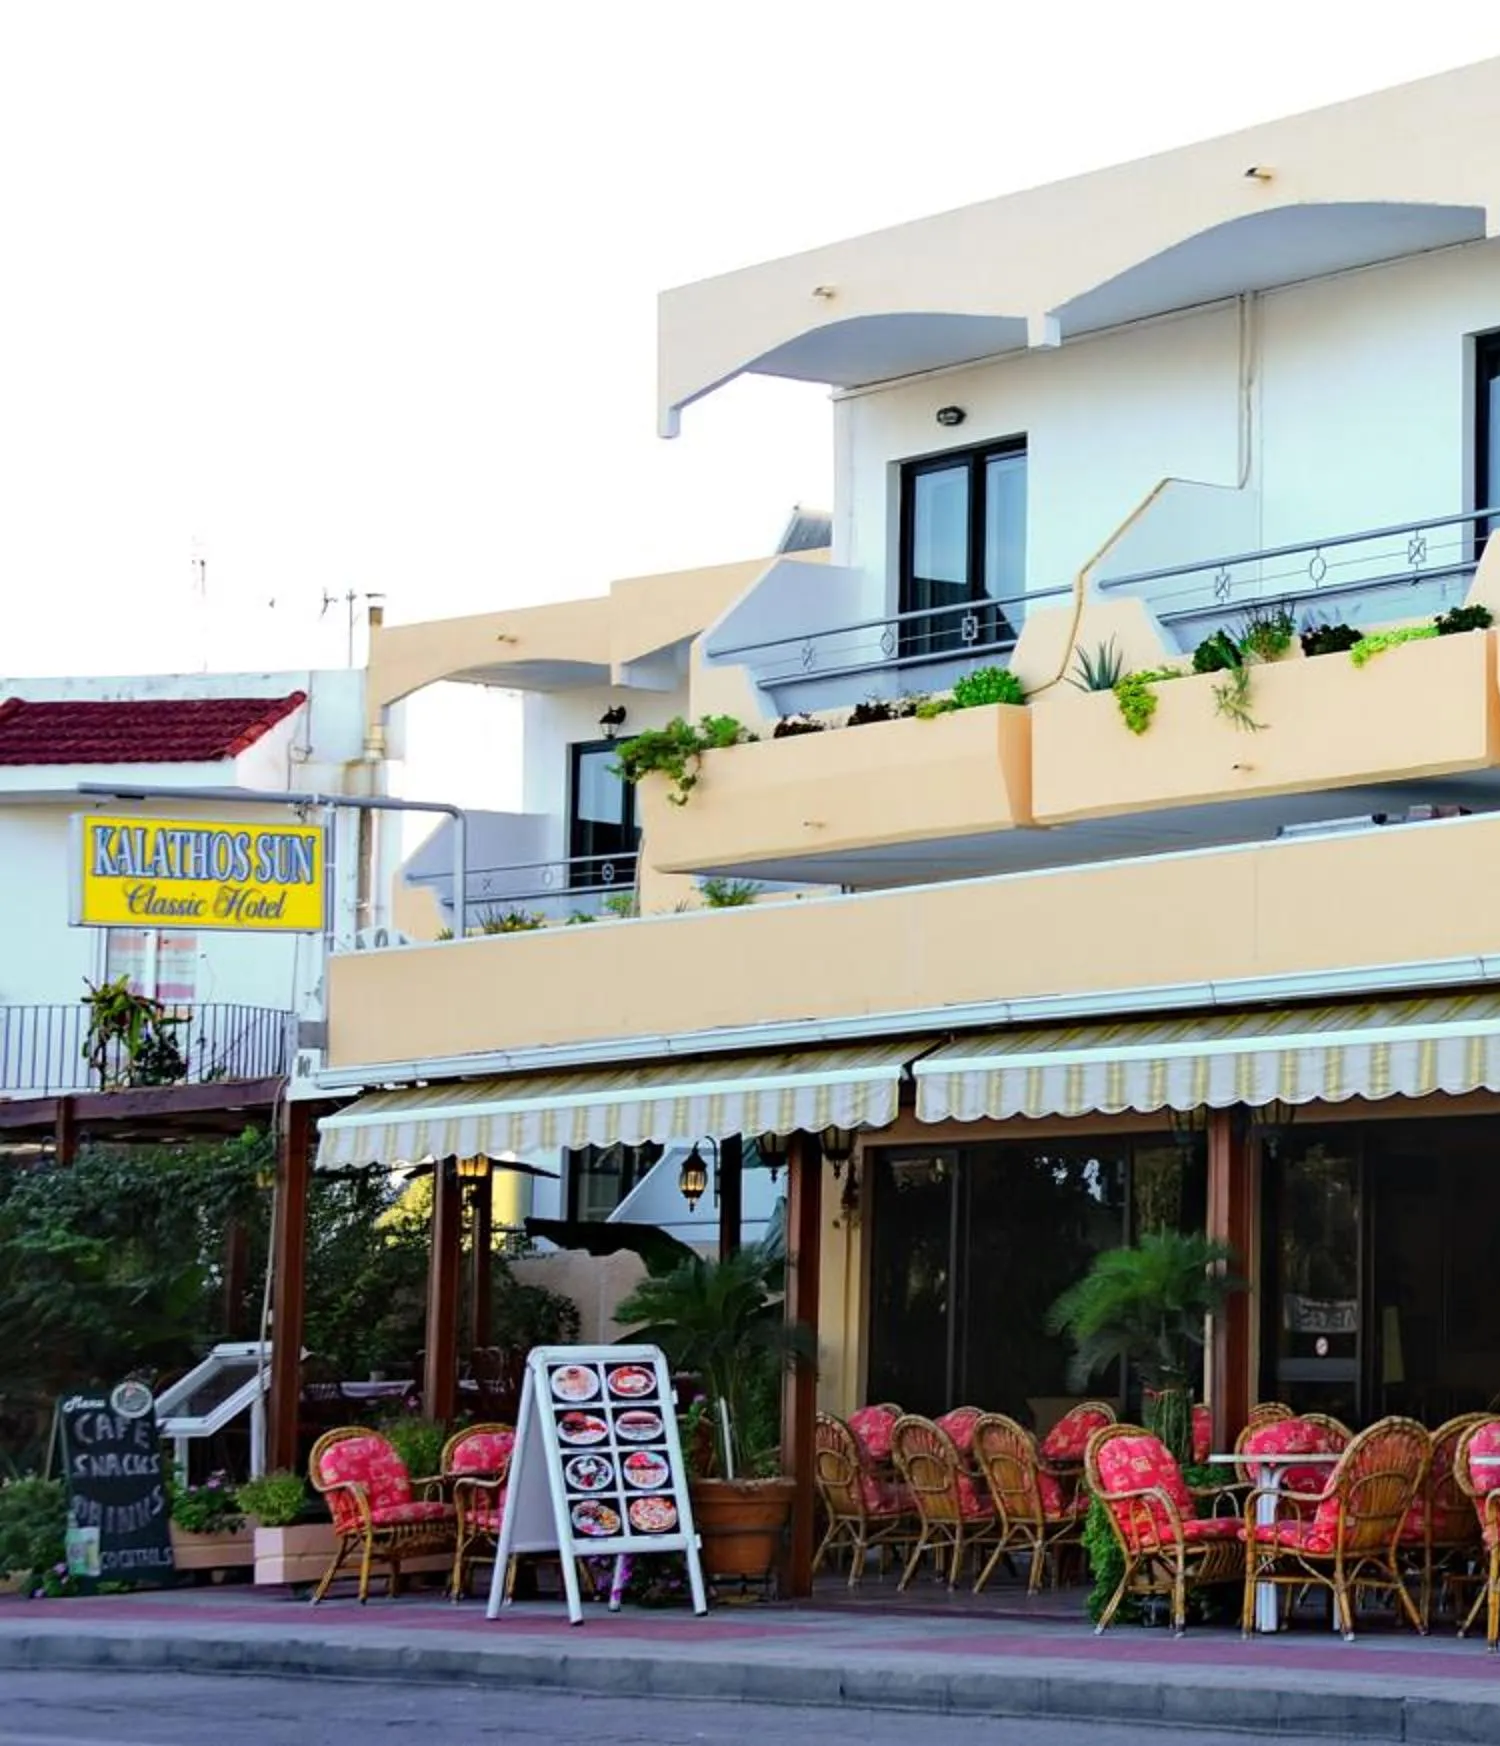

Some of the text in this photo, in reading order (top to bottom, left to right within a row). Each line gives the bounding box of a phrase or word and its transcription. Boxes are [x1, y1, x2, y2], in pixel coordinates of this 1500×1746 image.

[92, 825, 315, 885] KALATHOS SUN
[122, 880, 288, 924] Classic Hotel
[74, 1412, 151, 1448] CAFE
[73, 1453, 160, 1478] SNACKS
